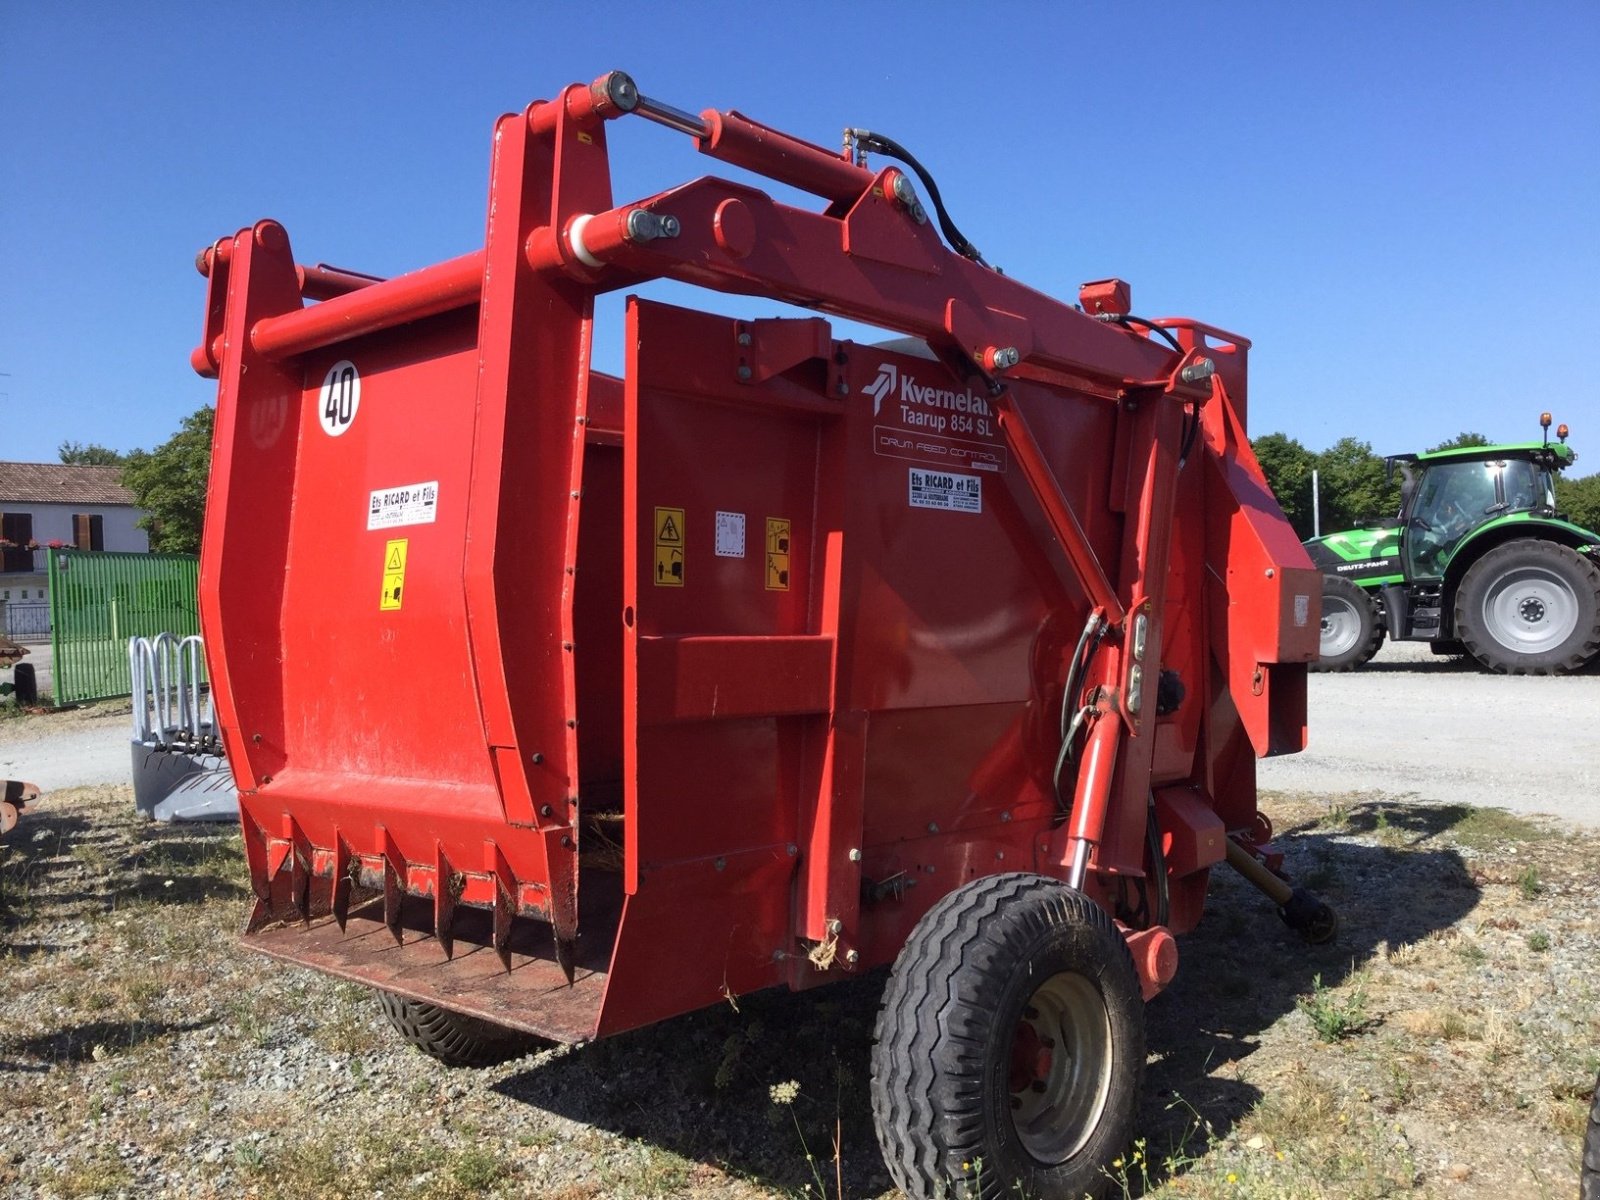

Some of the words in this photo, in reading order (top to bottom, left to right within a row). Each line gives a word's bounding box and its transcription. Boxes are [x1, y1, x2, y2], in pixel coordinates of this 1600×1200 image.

[325, 367, 354, 427] 40
[900, 405, 947, 432] Taarup
[950, 414, 973, 434] 854
[977, 418, 994, 437] SL
[880, 436, 914, 450] DRUM
[916, 442, 948, 455] FEED
[949, 447, 1003, 463] CONTROL
[911, 472, 923, 486] Ets
[925, 474, 954, 490] RICARD
[956, 480, 964, 491] et
[966, 479, 979, 493] Fils
[372, 495, 382, 508] Ets
[384, 490, 410, 507] RICARD
[412, 489, 420, 502] et
[422, 486, 435, 501] Fils
[1336, 560, 1389, 572] DEUTZ-FAHR
